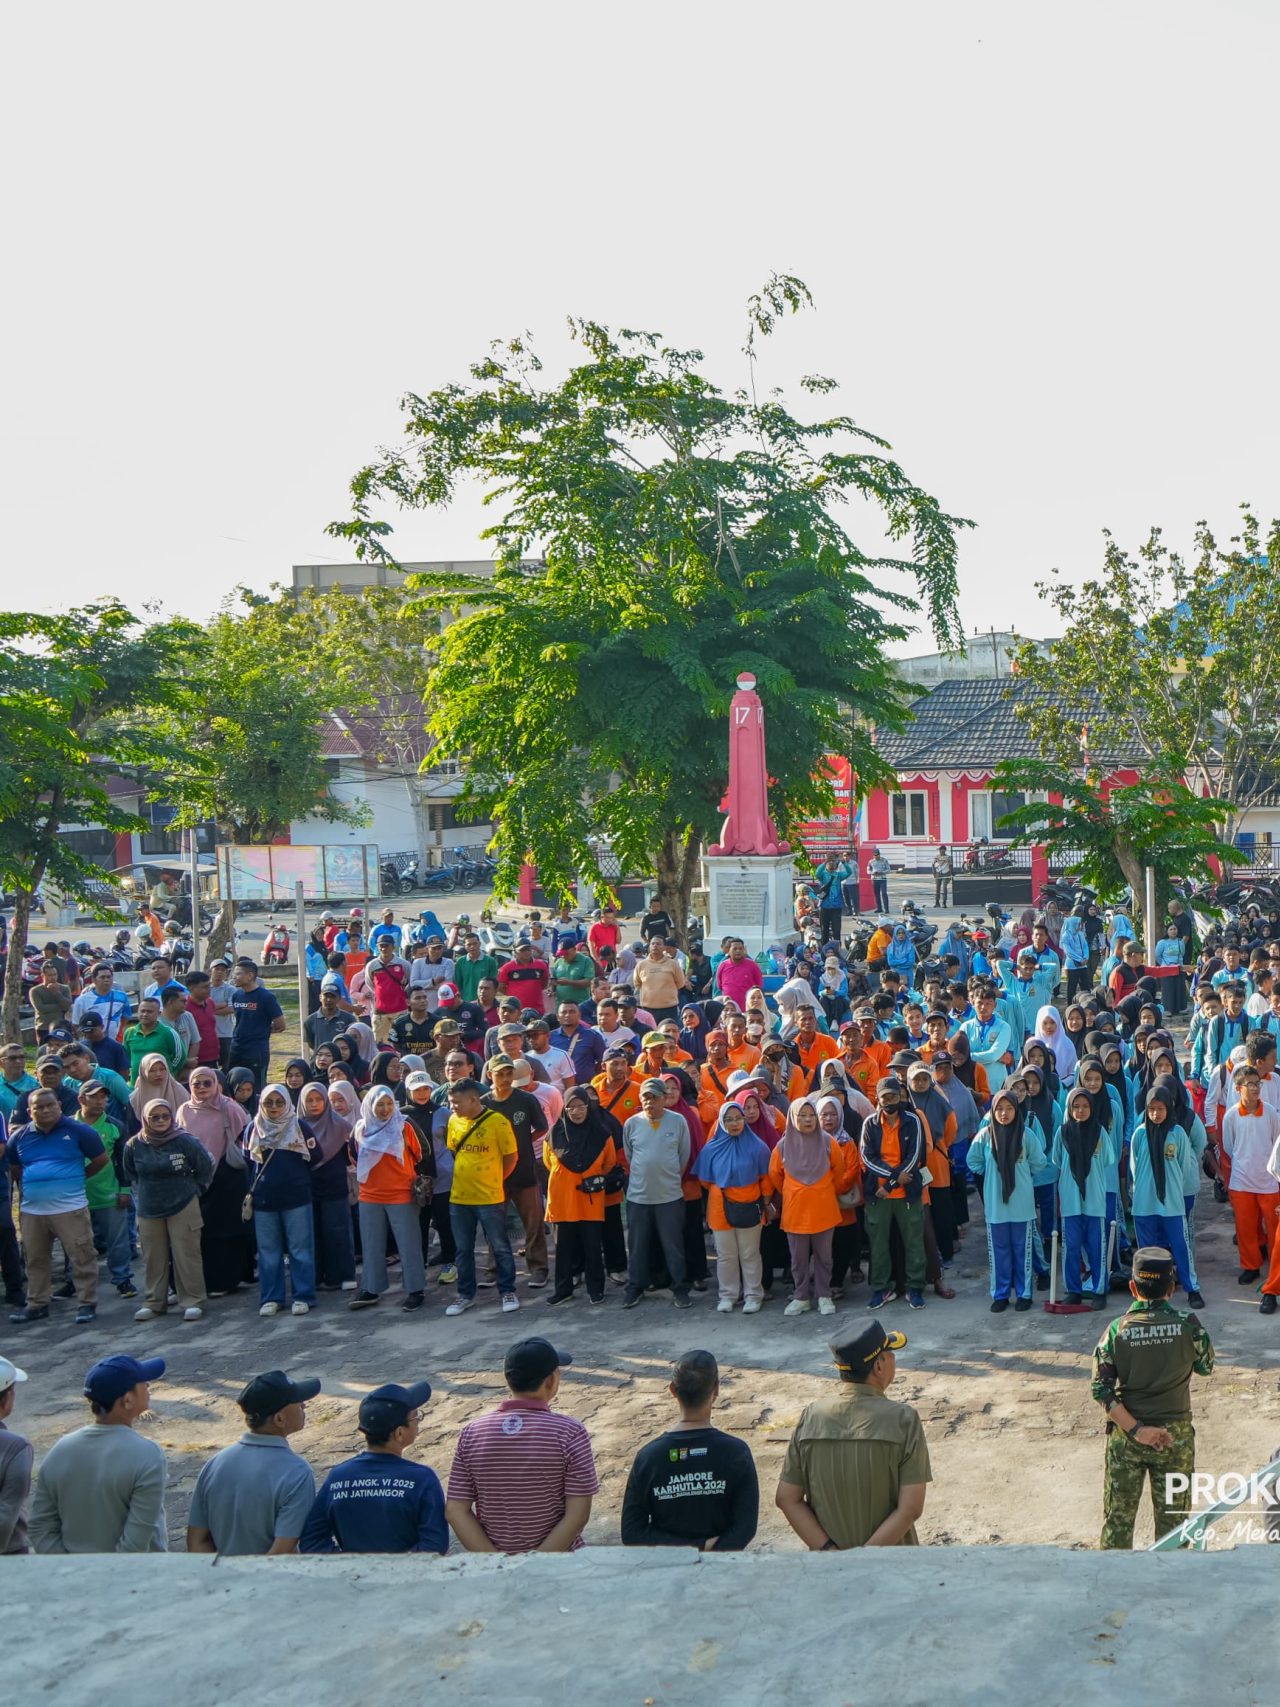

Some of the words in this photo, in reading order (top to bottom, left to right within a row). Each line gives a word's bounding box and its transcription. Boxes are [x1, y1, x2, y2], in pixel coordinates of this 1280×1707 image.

[735, 706, 750, 724] 17
[1121, 1324, 1182, 1340] PELATIH
[351, 1479, 379, 1487] ANGK.
[392, 1479, 415, 1489] 2025
[668, 1471, 713, 1485] JAMBORE
[333, 1491, 348, 1500] LAN
[350, 1489, 405, 1498] JATINANGOR
[653, 1481, 703, 1497] KARHUTLA
[704, 1480, 726, 1490] 2025
